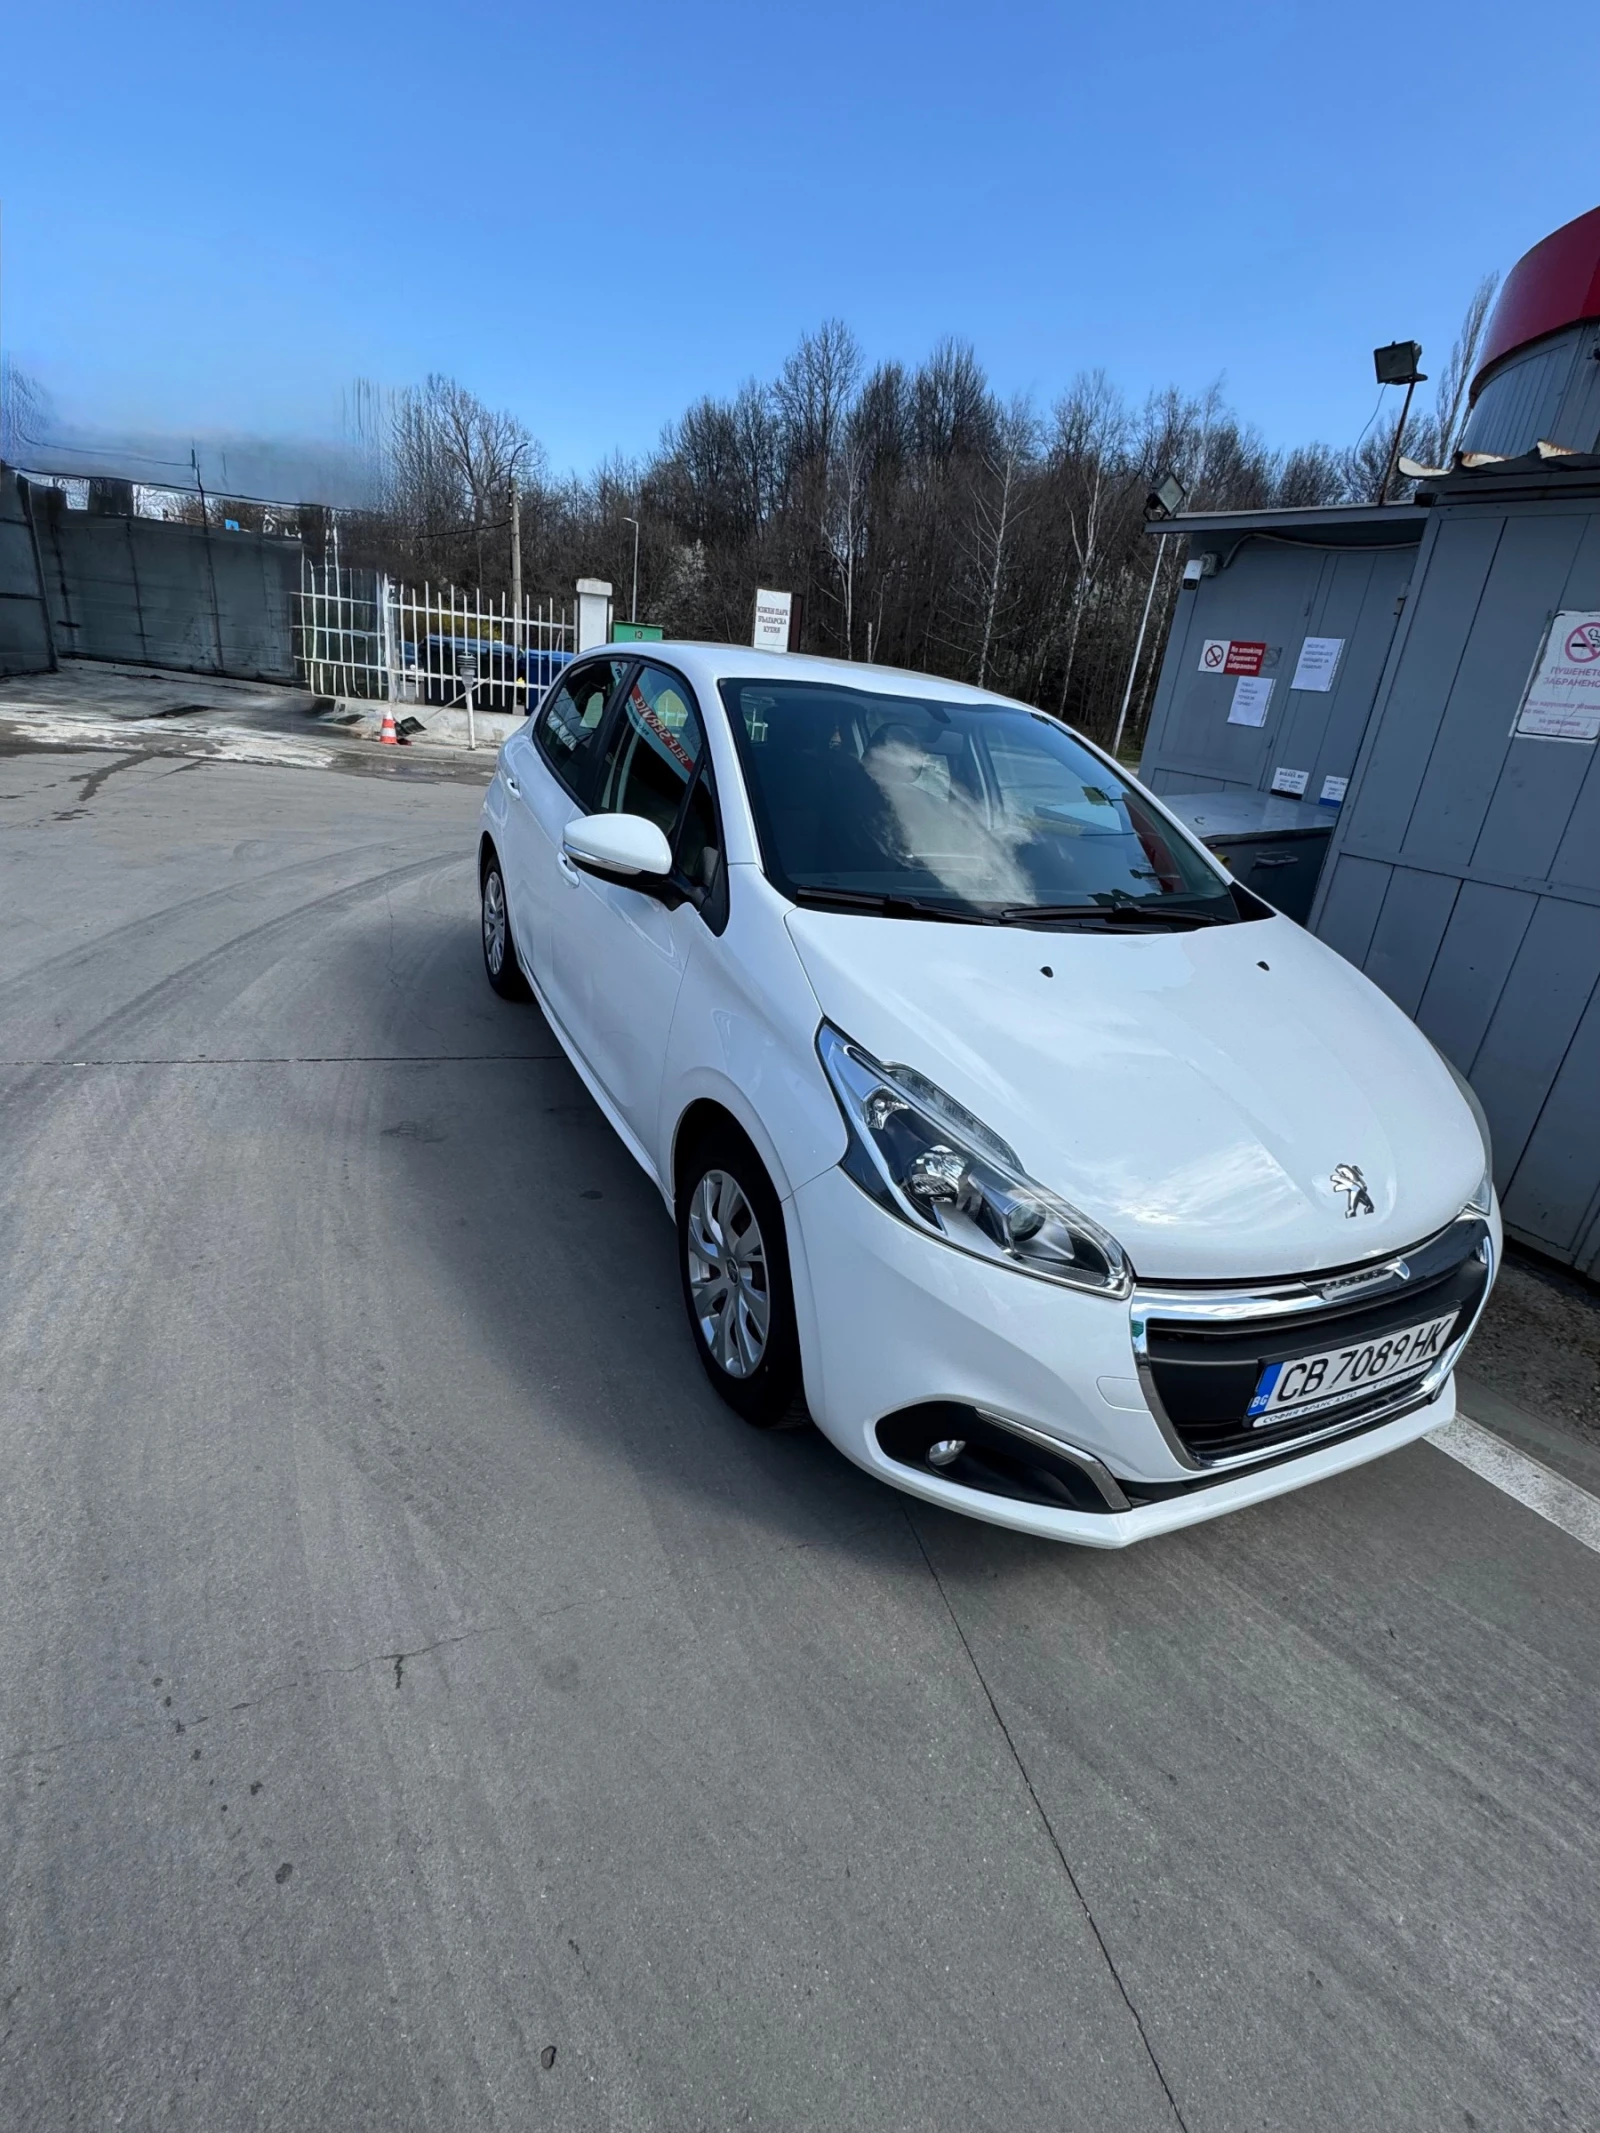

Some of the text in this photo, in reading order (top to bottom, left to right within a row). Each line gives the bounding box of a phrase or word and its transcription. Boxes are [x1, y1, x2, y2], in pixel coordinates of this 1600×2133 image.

[1277, 1318, 1452, 1402] CB 7089 HK
[1251, 1394, 1270, 1408] BG
[1263, 1408, 1300, 1424] СОФИЯ
